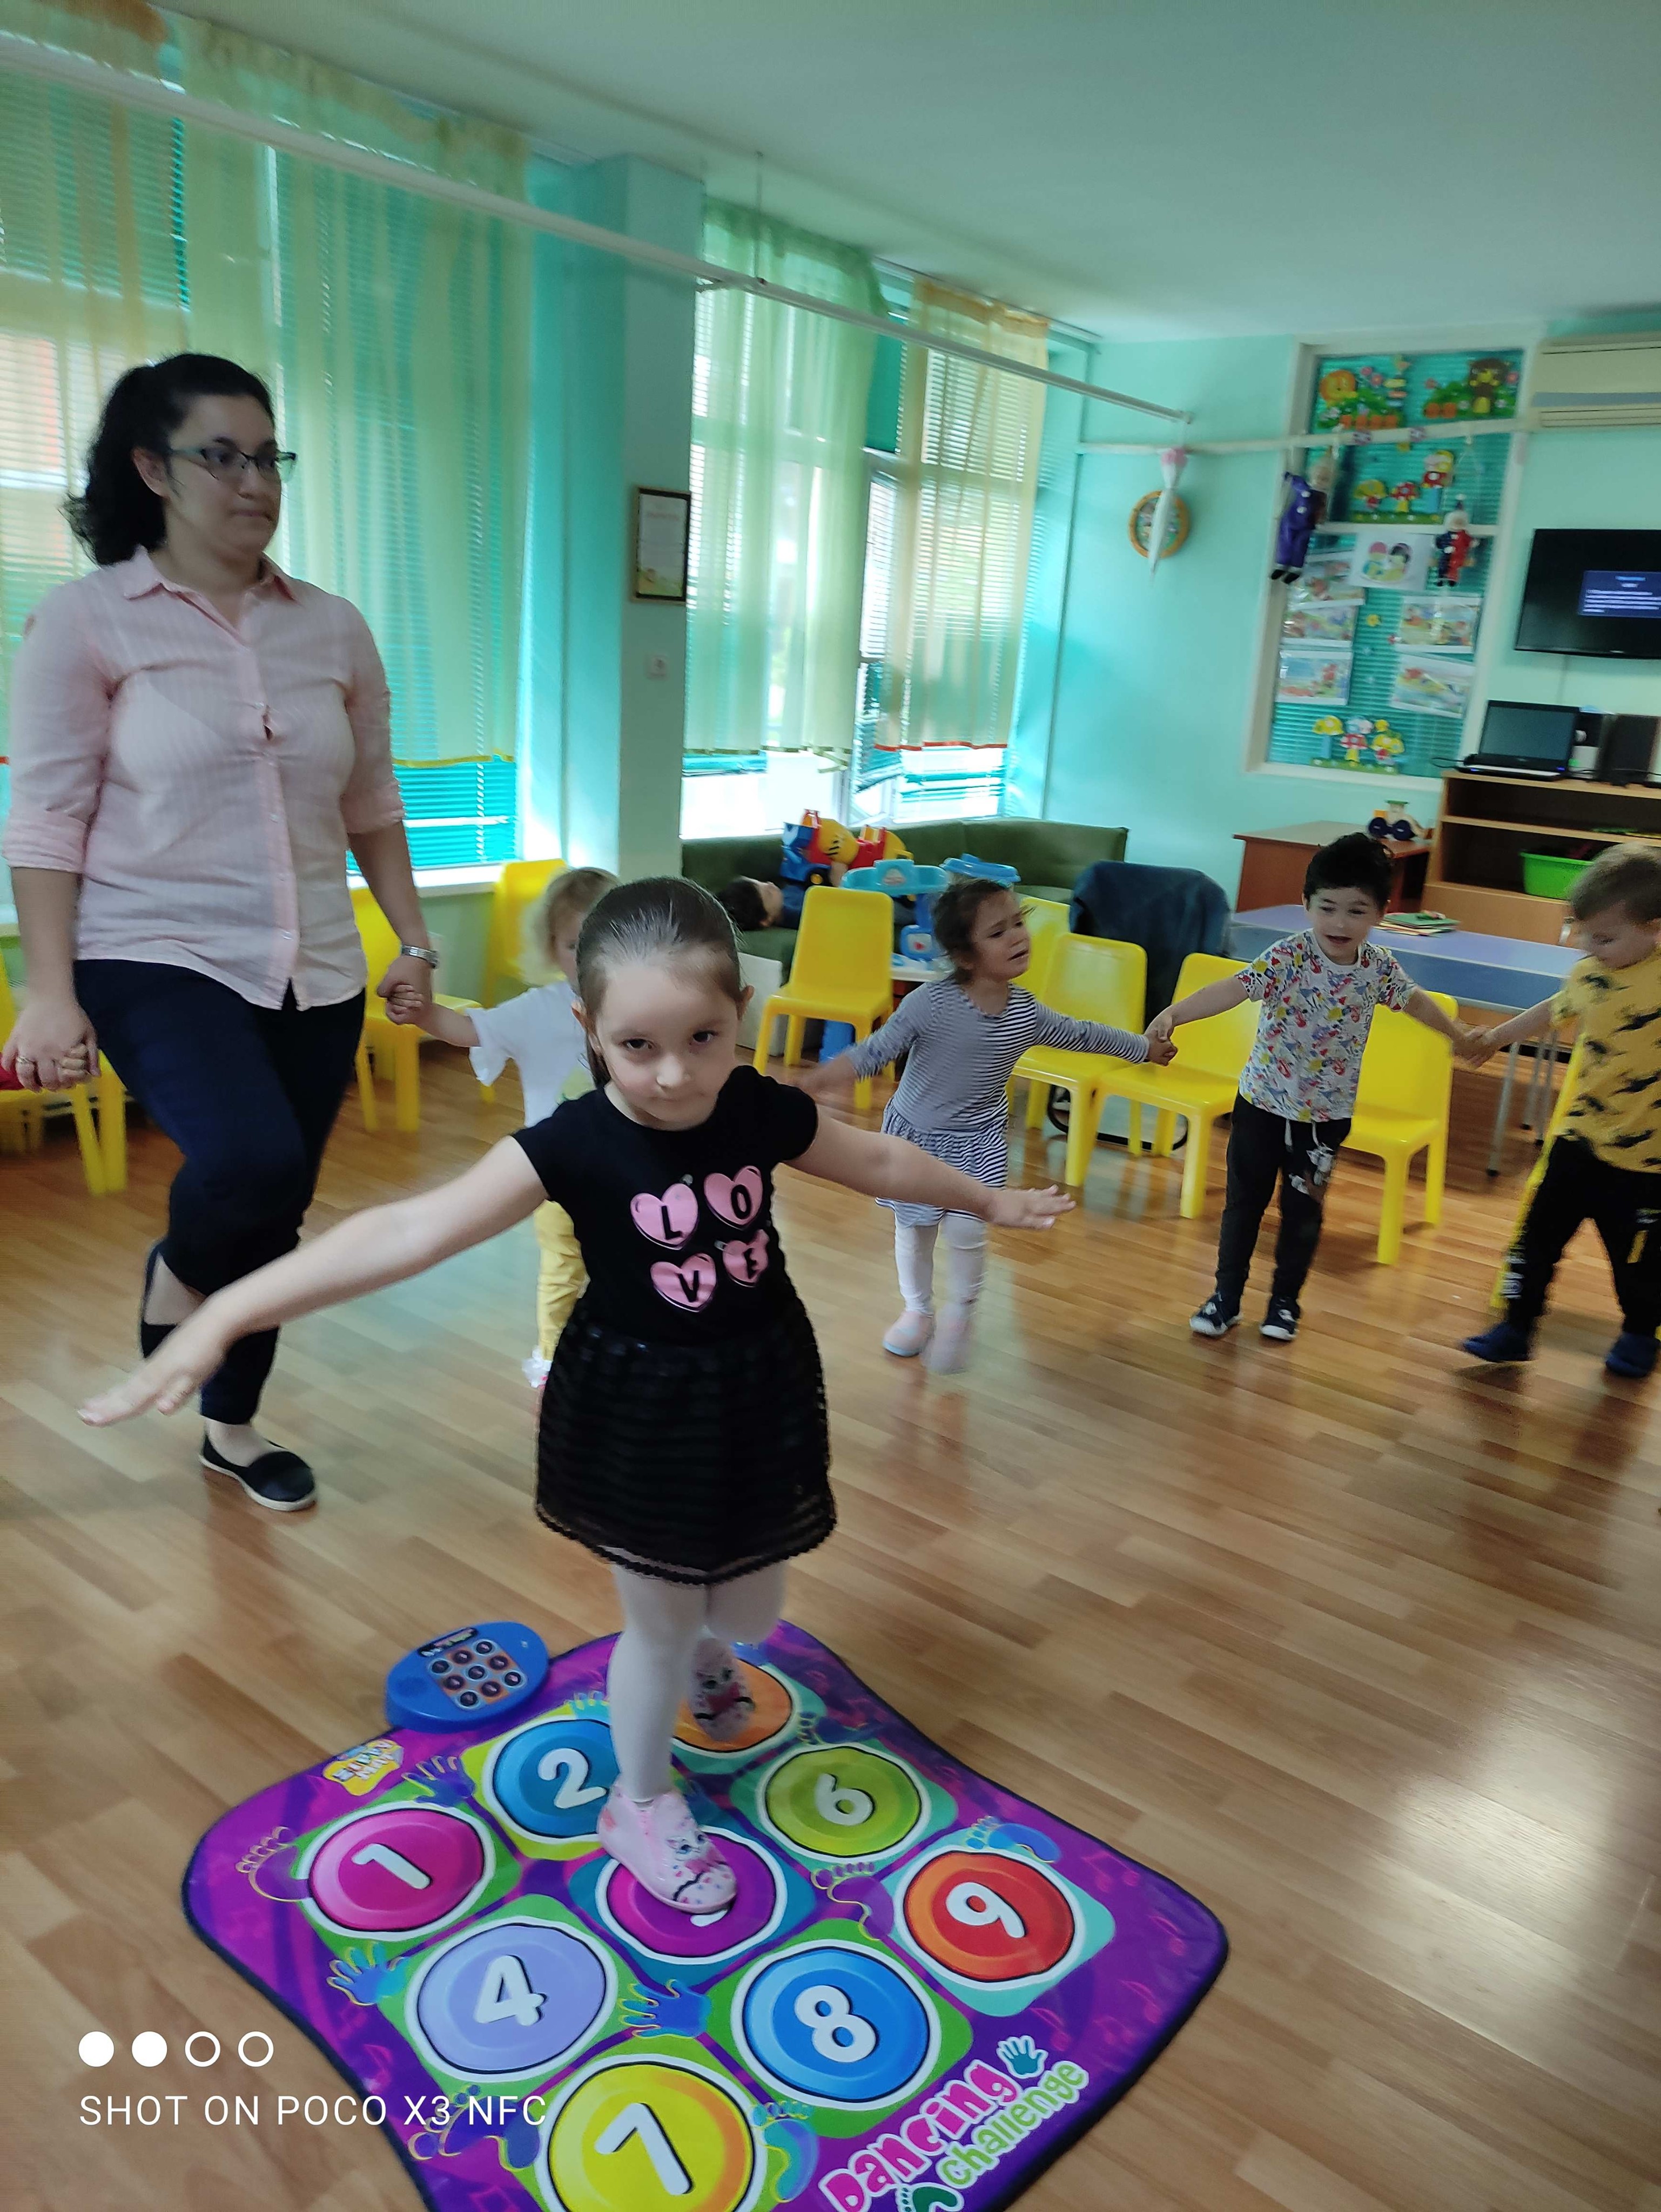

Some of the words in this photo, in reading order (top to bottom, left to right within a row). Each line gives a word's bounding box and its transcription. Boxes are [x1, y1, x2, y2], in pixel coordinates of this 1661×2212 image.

[540, 1748, 607, 1809] 2
[814, 1773, 875, 1826] 6
[352, 1843, 431, 1890] 1
[945, 1881, 1025, 1939] 9
[475, 1955, 546, 2026] 4
[795, 1985, 877, 2063] 8
[594, 2103, 691, 2196] 7
[821, 2061, 1021, 2212] Dancing
